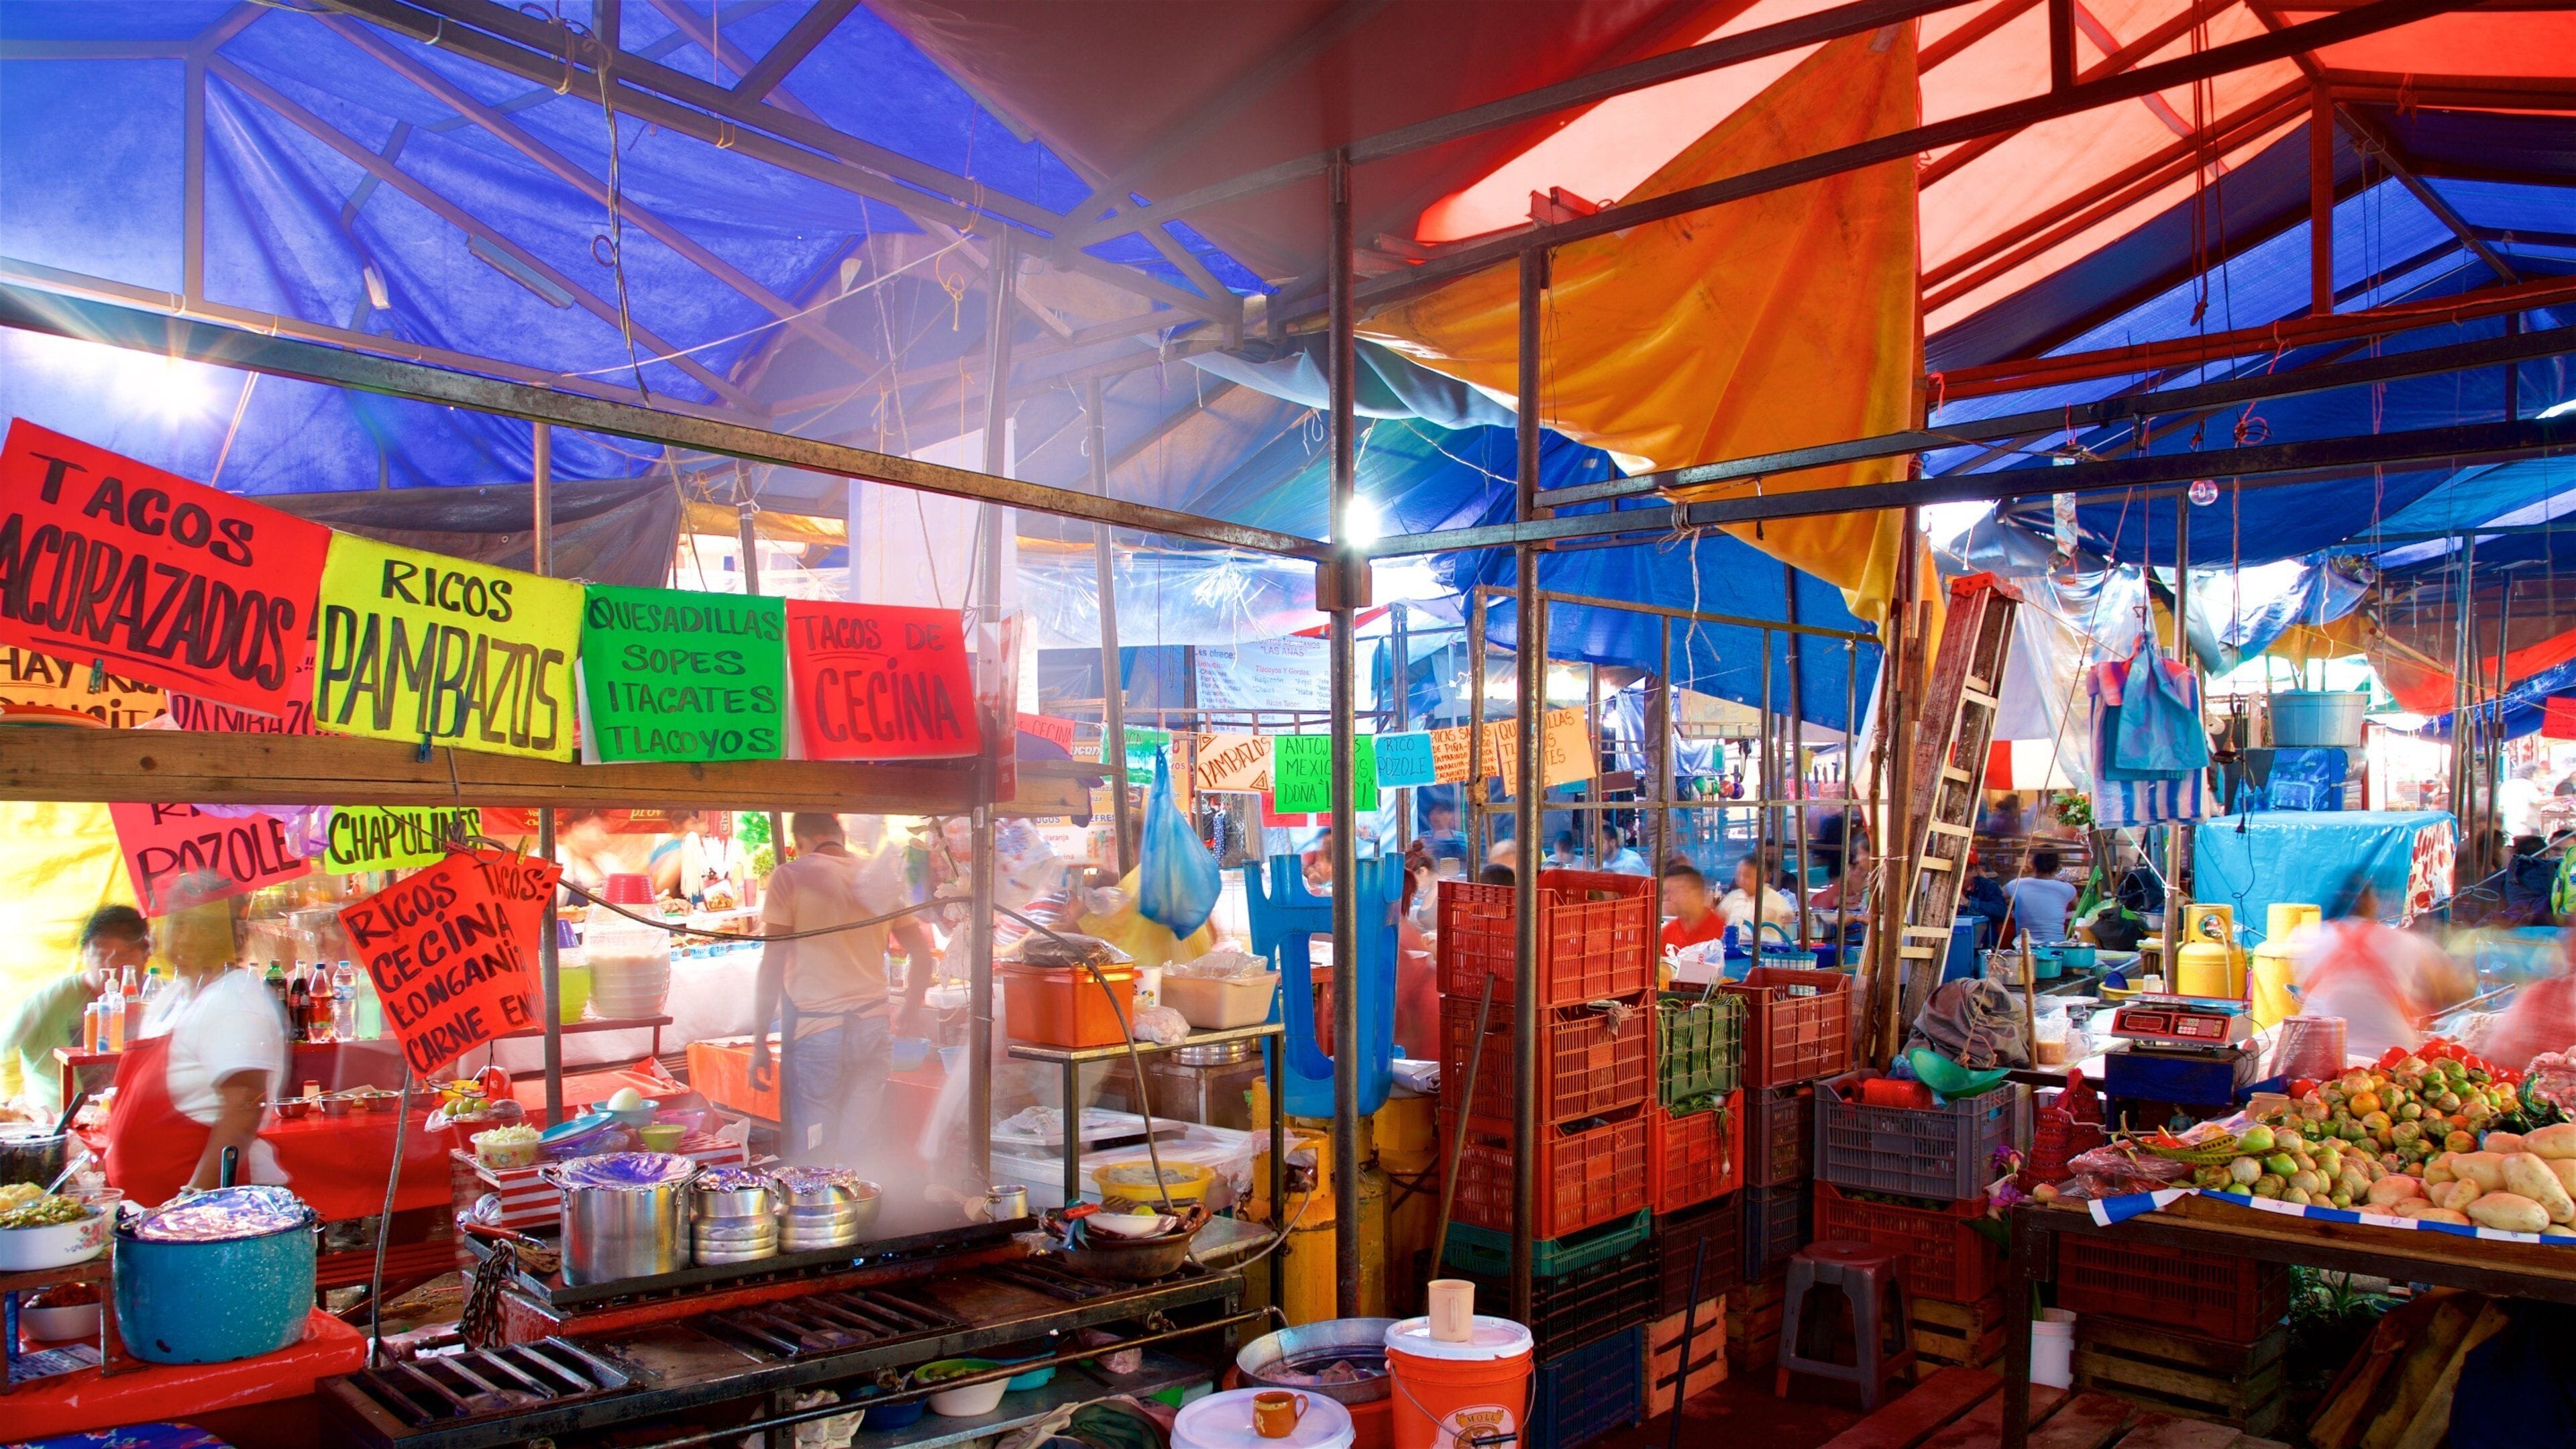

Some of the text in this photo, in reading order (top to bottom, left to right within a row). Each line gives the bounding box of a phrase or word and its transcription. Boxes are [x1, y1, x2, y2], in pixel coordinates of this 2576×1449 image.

[30, 451, 254, 568] TACOS
[0, 513, 296, 692] ACORAZADOS
[381, 559, 513, 623] RICOS
[588, 596, 784, 642] QUESADILLAS
[794, 614, 945, 651] TACOS DE
[317, 604, 564, 752] PAMBAZOS
[623, 644, 747, 676] SOPES
[608, 680, 776, 716] ITACATES
[816, 657, 963, 743] CECINA
[604, 724, 776, 759] TLACOYOS
[1198, 737, 1271, 788] PAMBAZOS
[1285, 737, 1361, 755] ANTOJS
[1376, 757, 1428, 777] POZOLE
[1383, 738, 1415, 752] RICO
[1279, 781, 1317, 805] DOÑA
[328, 807, 481, 865] CHAPULINES
[1036, 816, 1061, 824] UGOS
[1046, 834, 1069, 842] aranja
[137, 818, 301, 908] POZOLE
[347, 872, 457, 949] RICOS
[372, 902, 515, 994] CECINA
[388, 939, 528, 1030] LONGANIZ
[405, 1005, 490, 1075] CARNE
